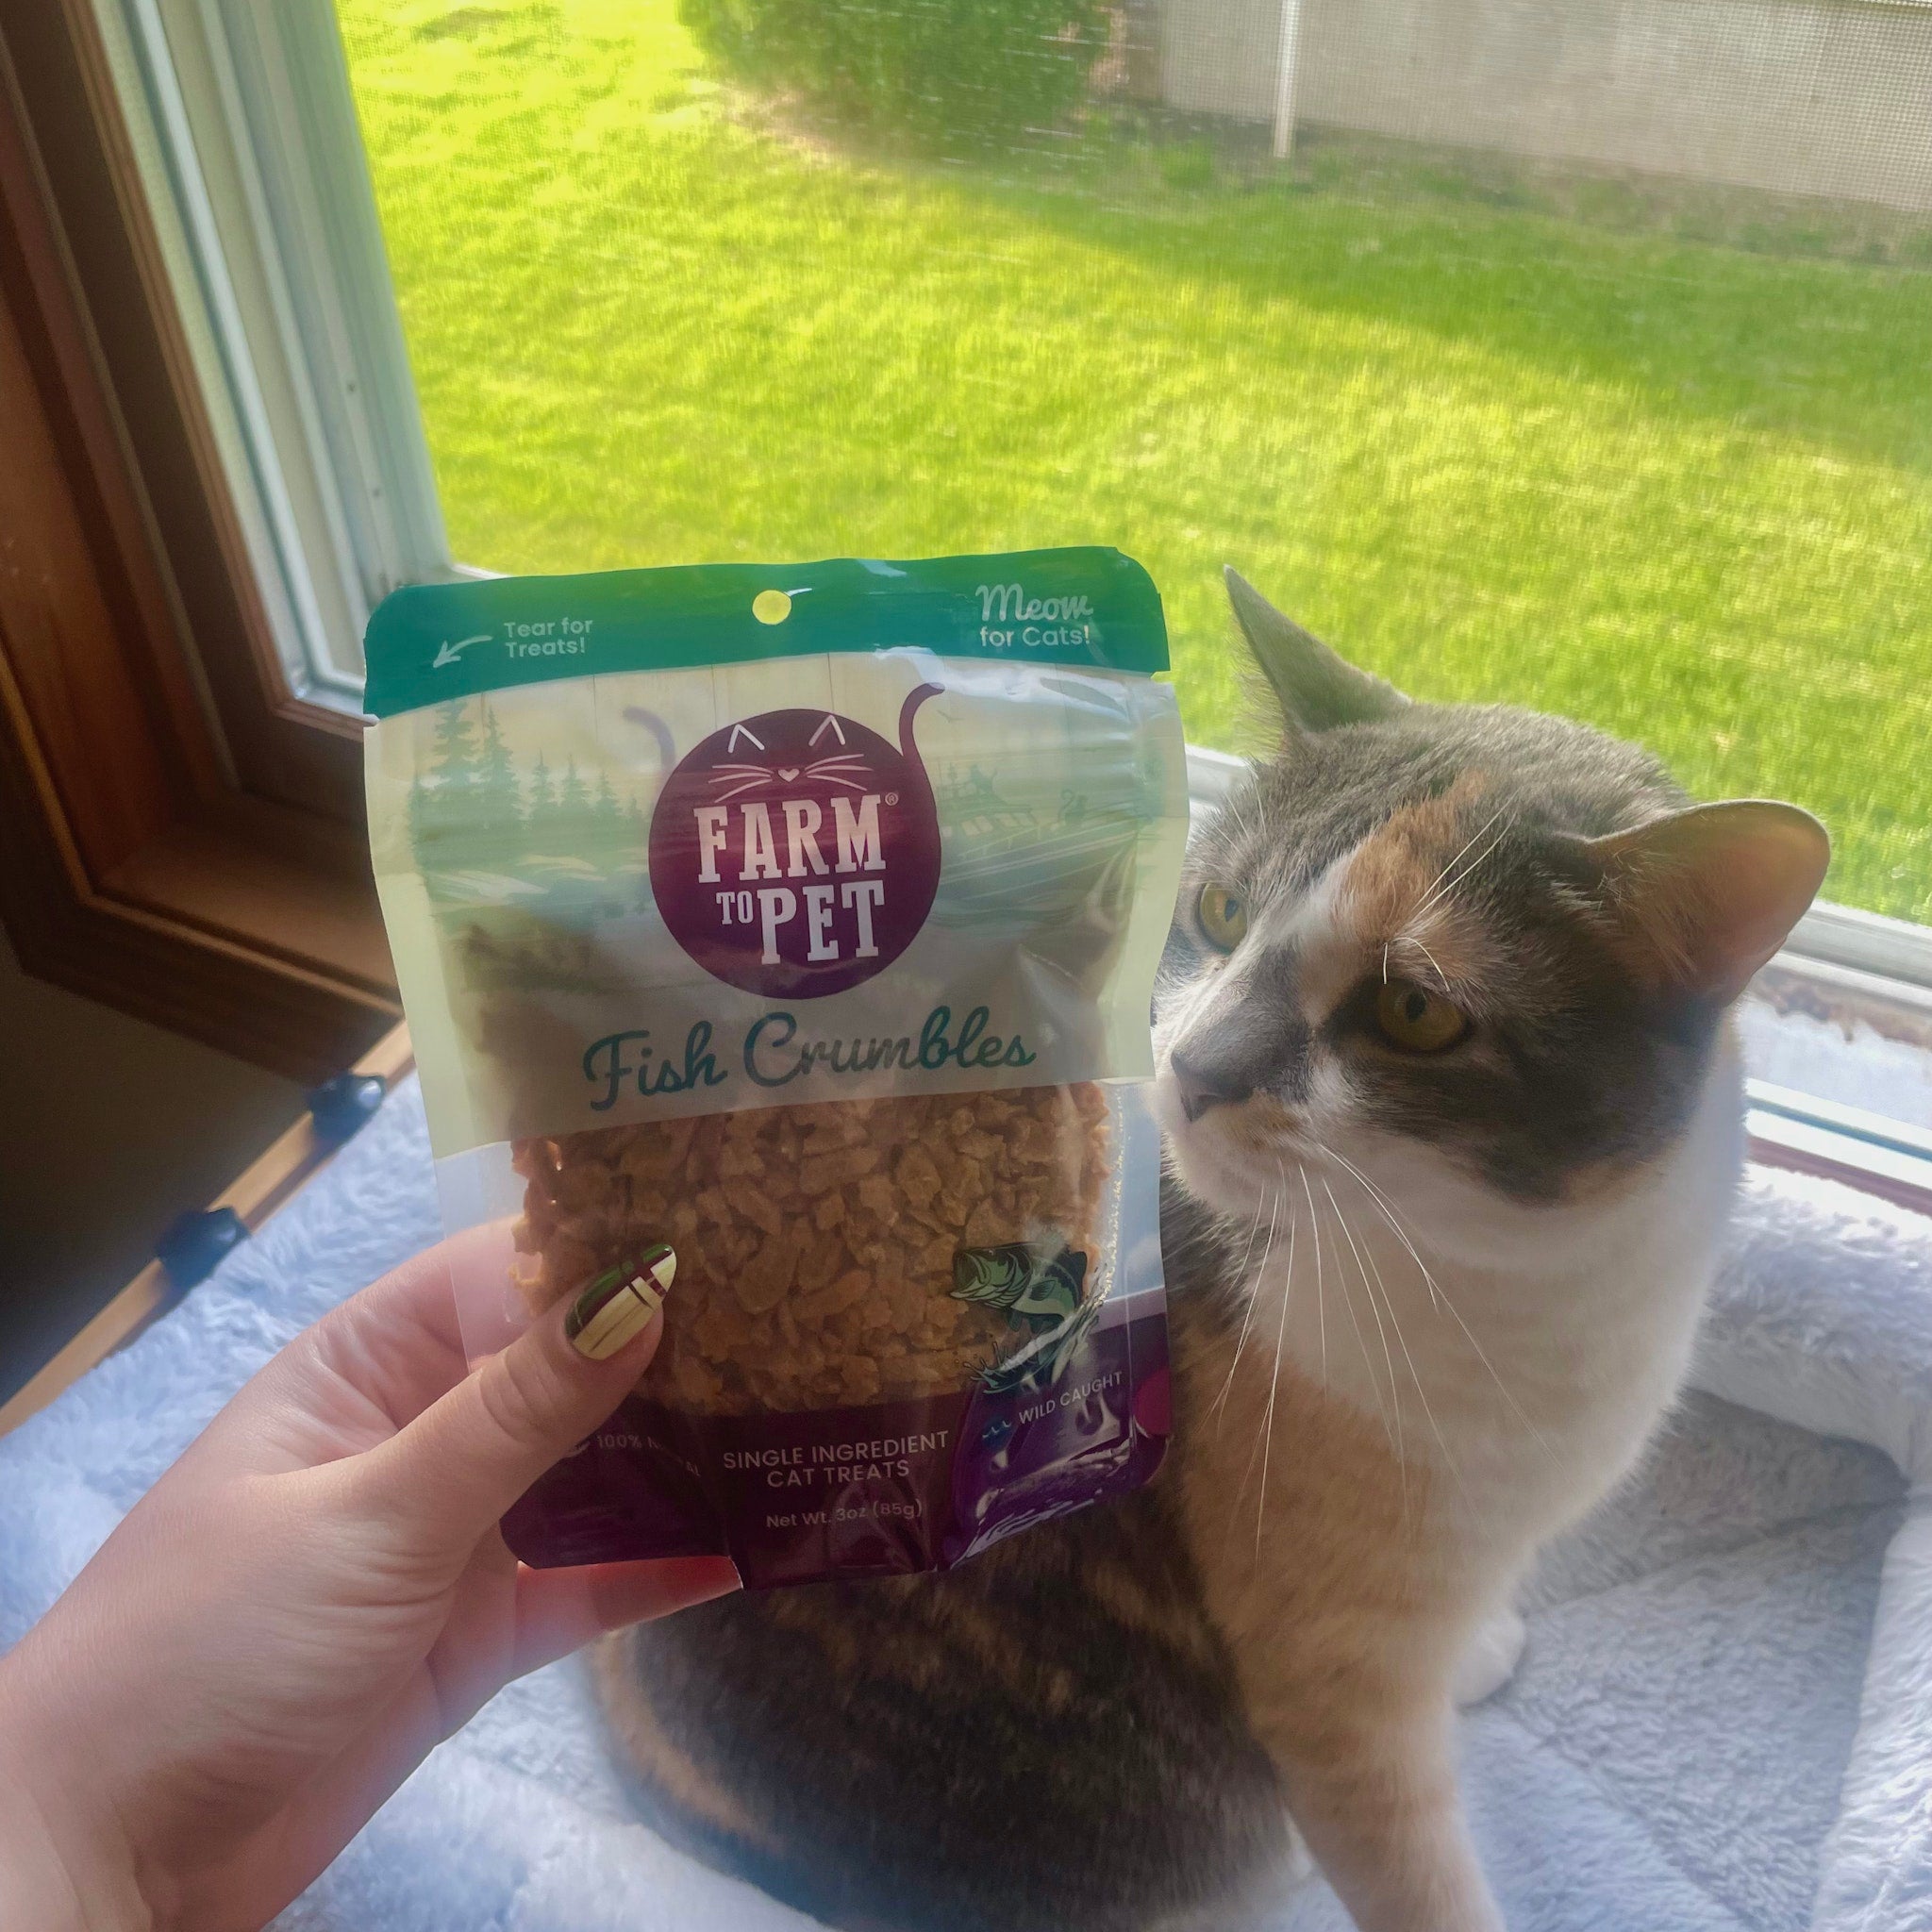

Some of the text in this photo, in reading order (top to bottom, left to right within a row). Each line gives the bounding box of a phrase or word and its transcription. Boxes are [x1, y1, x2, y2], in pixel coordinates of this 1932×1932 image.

[974, 583, 1094, 622] Meow
[503, 617, 593, 638] Tear for
[979, 625, 1091, 647] for Cats!
[505, 637, 585, 658] Treats!
[715, 880, 885, 965] TO PET
[583, 1006, 1037, 1111] Fish Crumbles
[1019, 1371, 1124, 1424] WILD CAUGHT
[597, 1433, 642, 1450] 100%
[723, 1447, 805, 1470] SINGLE
[811, 1430, 949, 1463] INGREDIENT
[766, 1458, 910, 1489] CAT TREATS
[766, 1498, 923, 1528] Net Wt. 3oz (85g)
